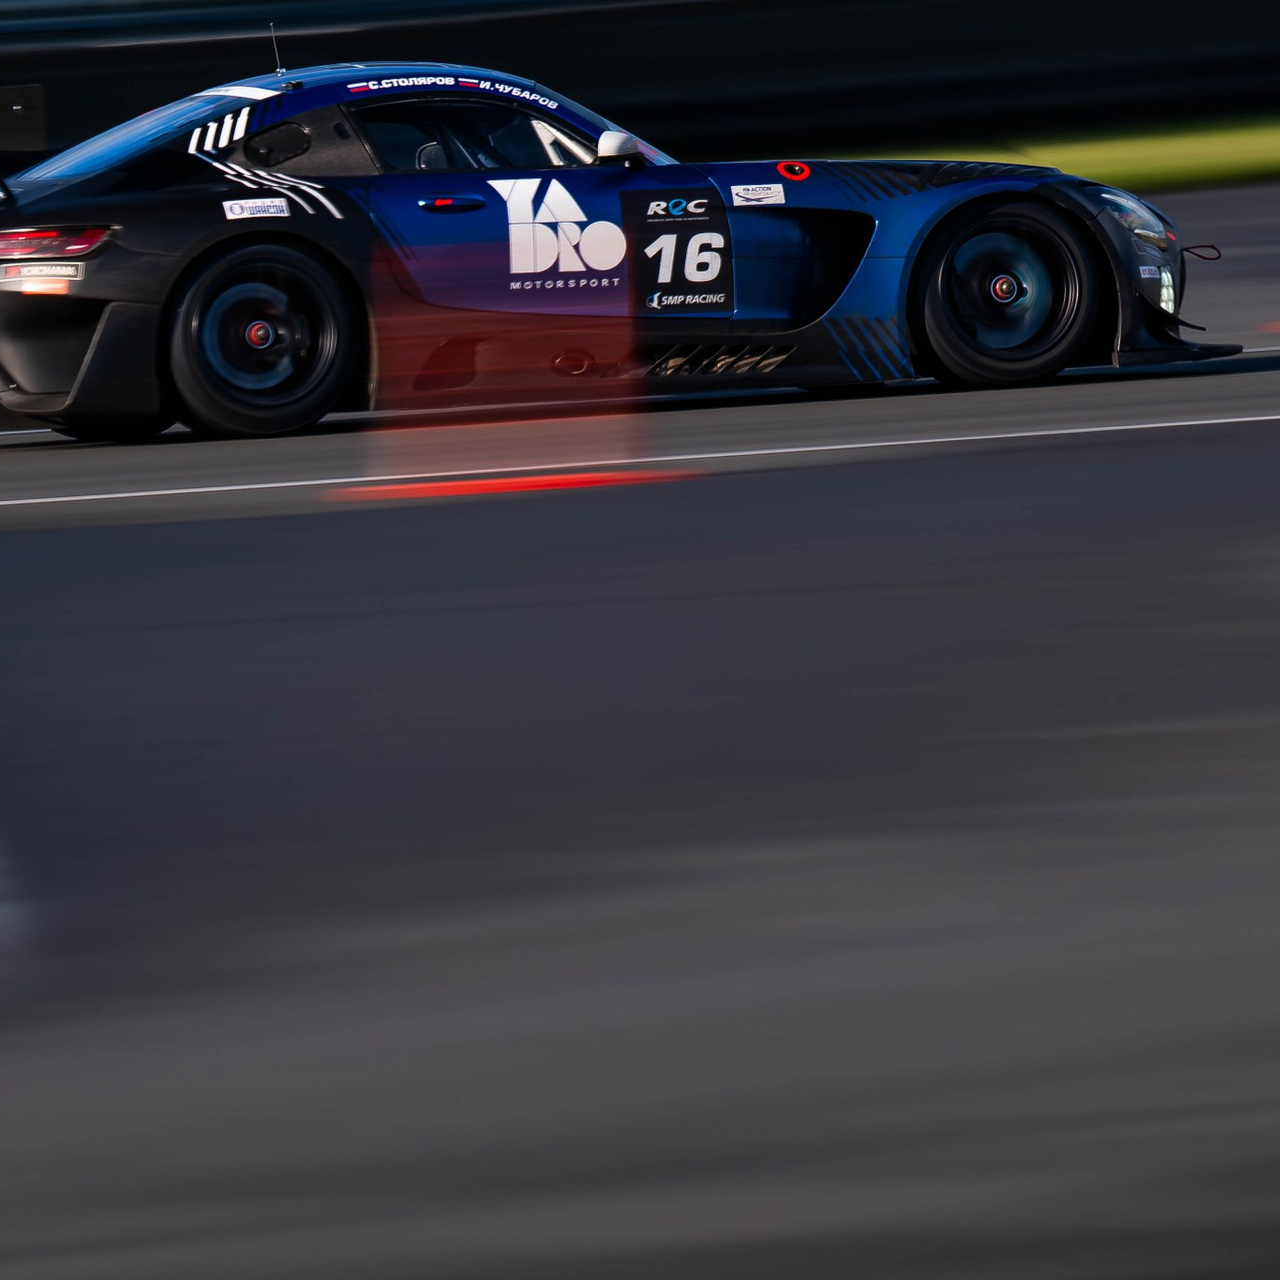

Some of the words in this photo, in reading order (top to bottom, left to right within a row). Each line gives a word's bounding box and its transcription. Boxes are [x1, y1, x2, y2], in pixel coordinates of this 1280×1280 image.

[368, 76, 455, 90] С.СТОЛЯРОВ
[479, 80, 559, 110] И.ЧУБАРОВ
[644, 232, 725, 284] 16
[510, 278, 621, 290] MOTORSPORT
[661, 295, 684, 306] SMP
[685, 293, 726, 305] RACING
